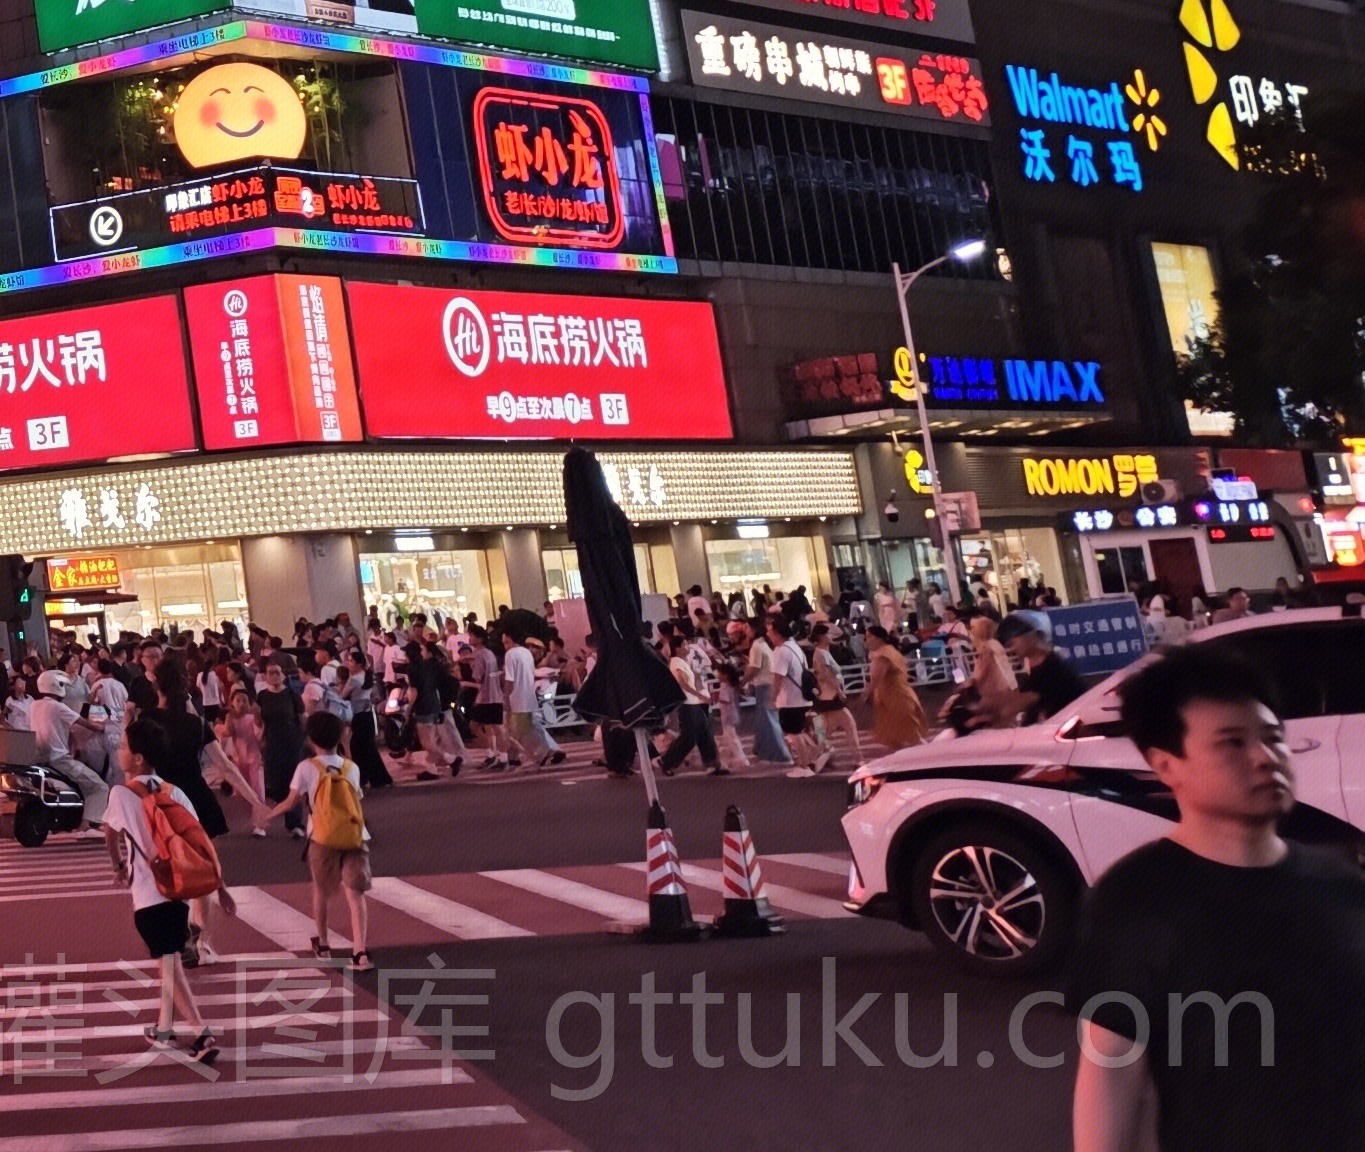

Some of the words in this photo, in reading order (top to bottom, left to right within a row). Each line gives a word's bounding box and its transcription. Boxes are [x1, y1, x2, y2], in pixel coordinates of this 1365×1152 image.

[877, 64, 906, 100] 3F
[1006, 64, 1130, 133] Walmart
[494, 110, 604, 189] 虾小龙
[1020, 127, 1143, 192] 沃尔玛
[211, 176, 266, 203] 虾小龙
[327, 178, 381, 211] 虾小龙
[491, 311, 648, 369] 海底捞火锅
[229, 318, 260, 415] 海底捞火锅
[1002, 359, 1105, 403] IMAX
[239, 423, 255, 436] 3F
[607, 398, 626, 420] 3F
[34, 421, 62, 446] 3F
[1022, 457, 1115, 498] ROMON
